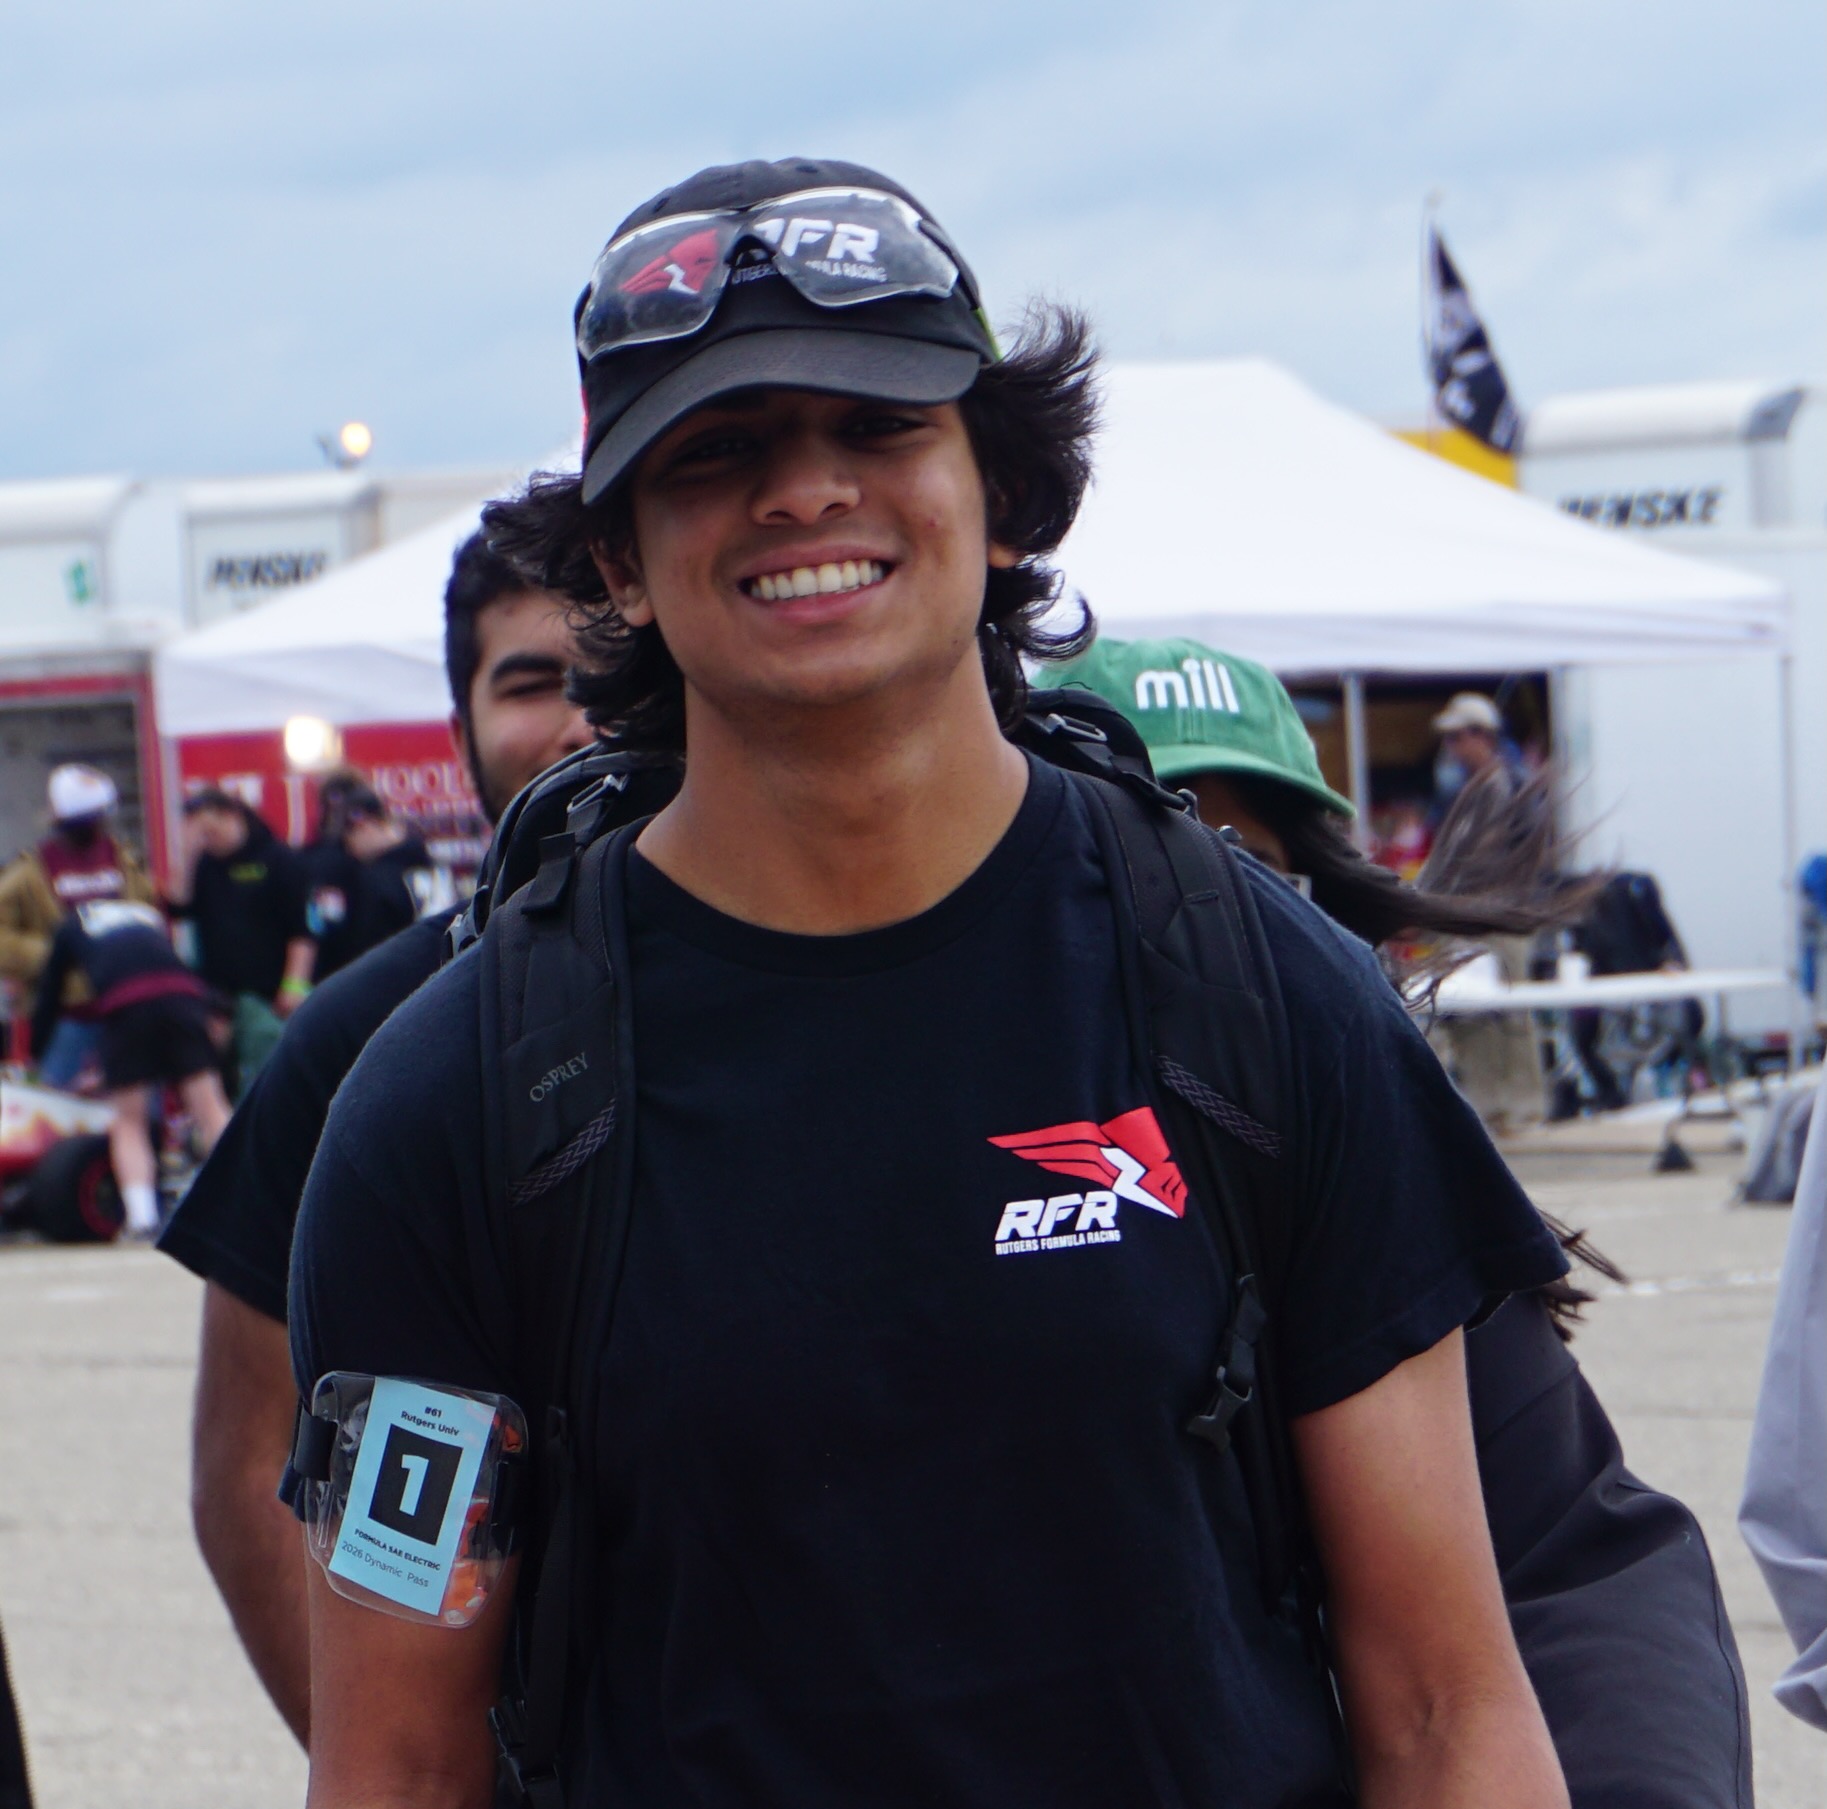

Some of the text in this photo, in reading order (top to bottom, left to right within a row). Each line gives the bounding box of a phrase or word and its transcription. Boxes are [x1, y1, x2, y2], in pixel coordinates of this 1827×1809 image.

[1135, 658, 1240, 714] mill
[529, 1052, 589, 1102] OSPREY
[994, 1190, 1118, 1241] RFR
[995, 1229, 1121, 1256] RUTGERS FORMULA RACING
[400, 1410, 460, 1436] Rutgers Univ
[424, 1406, 442, 1418] #61
[399, 1453, 429, 1517] 1
[341, 1541, 430, 1587] 2026 Dynamic Pass
[354, 1528, 441, 1571] FORMULA SAE ELECTRIC
